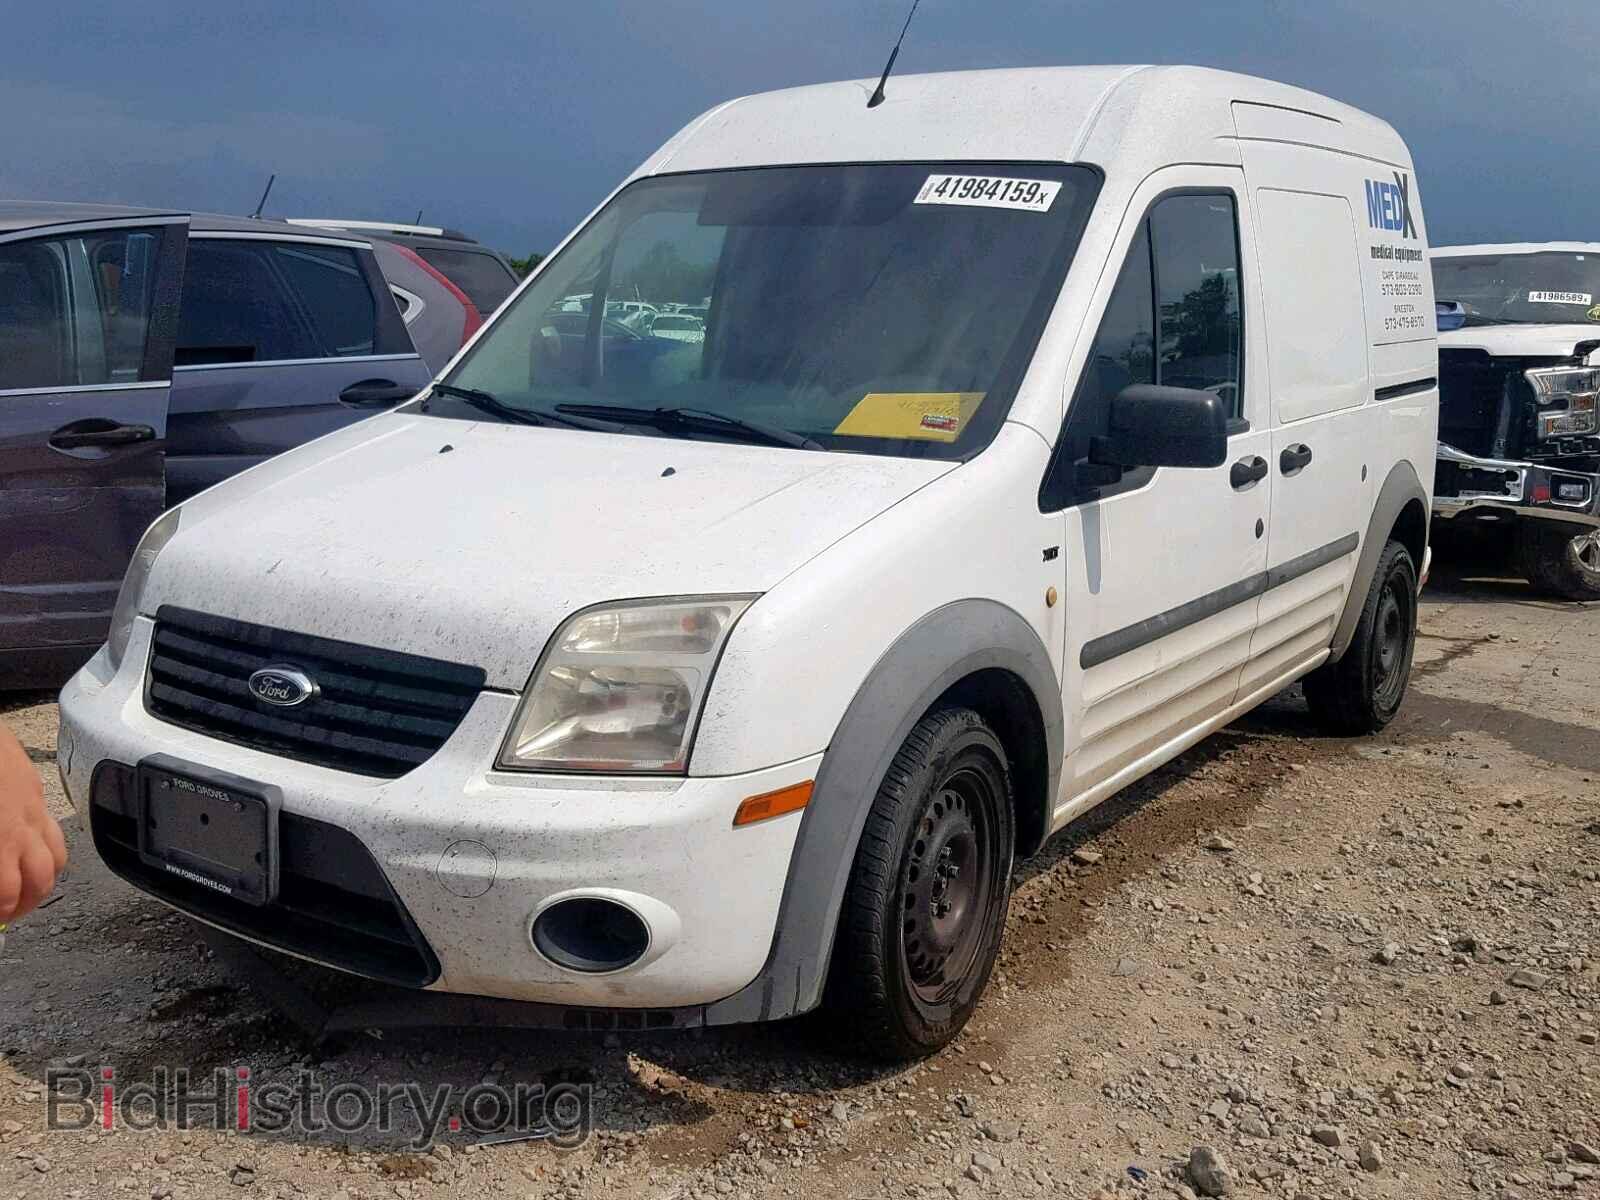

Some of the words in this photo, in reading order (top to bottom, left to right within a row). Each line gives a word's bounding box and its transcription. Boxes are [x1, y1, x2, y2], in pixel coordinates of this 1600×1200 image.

[1365, 171, 1417, 239] MEDX
[1370, 243, 1394, 259] medical
[1394, 246, 1423, 263] equipment
[259, 676, 291, 699] Ford
[172, 777, 196, 792] FORD
[196, 785, 230, 801] GROVES
[165, 863, 232, 895] WWW.FORDGROVES.COM
